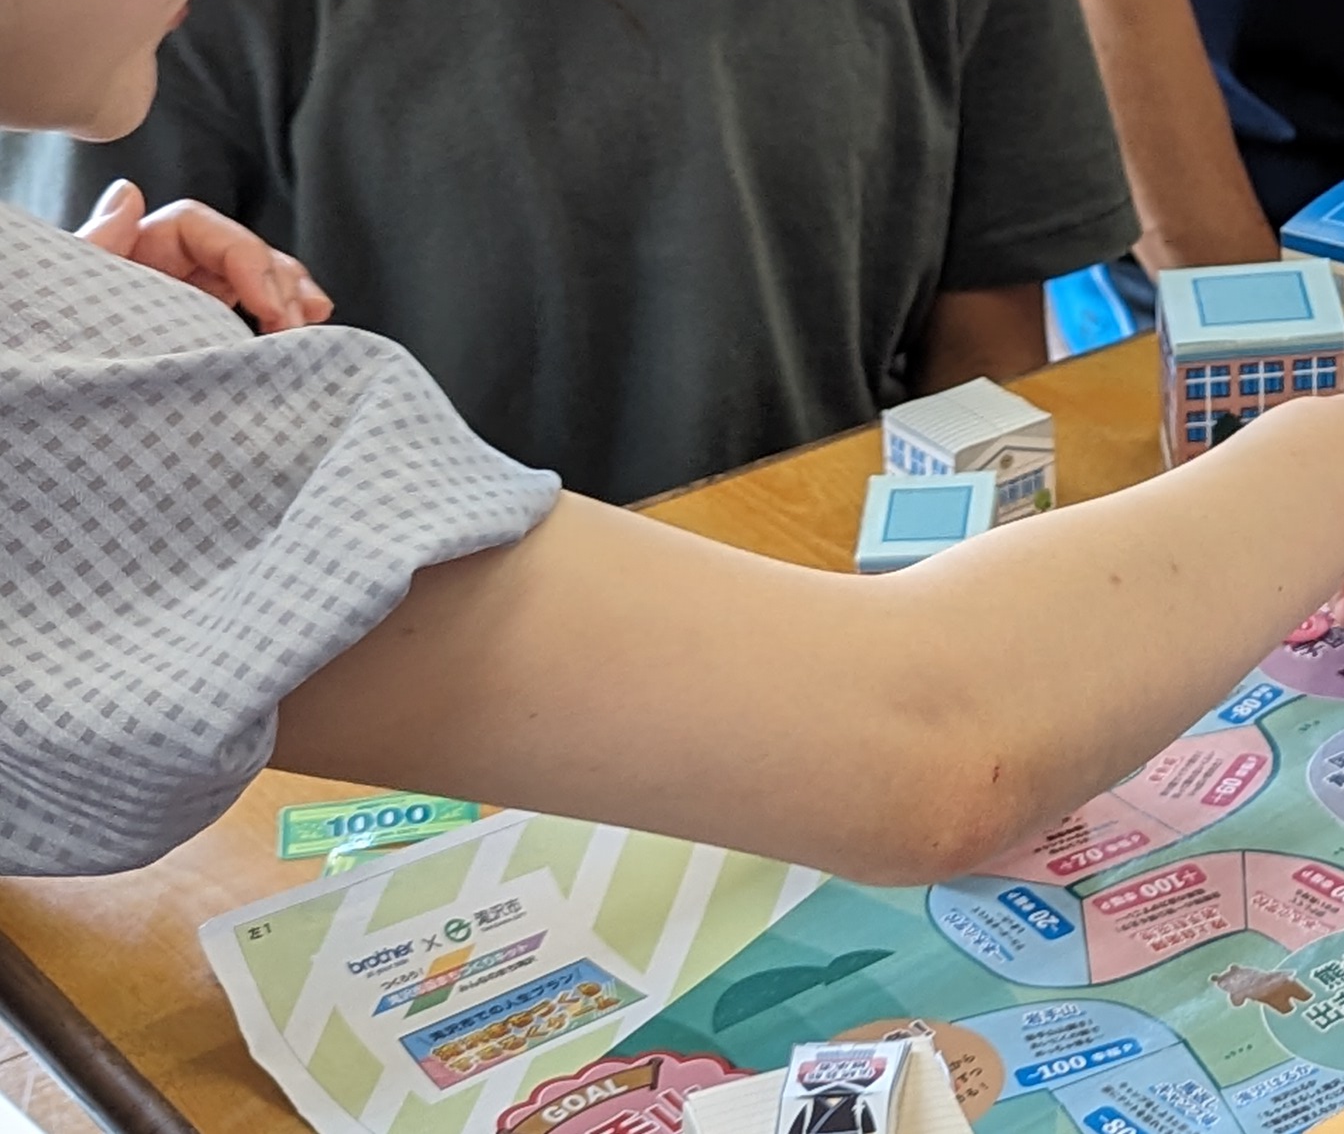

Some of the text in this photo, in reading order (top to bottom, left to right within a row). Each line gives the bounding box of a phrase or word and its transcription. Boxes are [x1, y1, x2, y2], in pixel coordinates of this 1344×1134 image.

[326, 803, 434, 837] 1000
[1139, 867, 1198, 896] +100
[348, 940, 415, 976] brother
[473, 897, 527, 930] 滝沢市
[541, 1077, 629, 1126] GOAL
